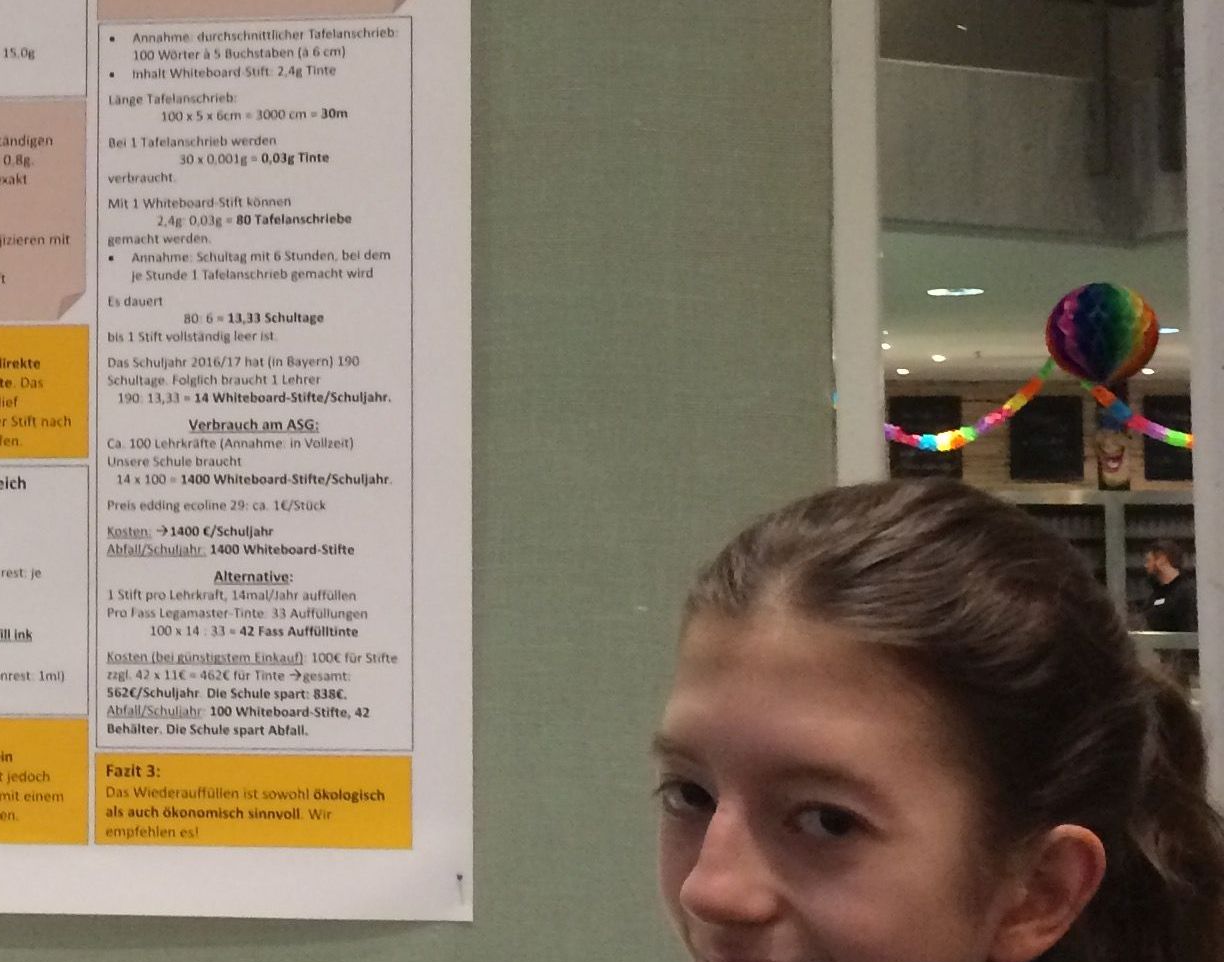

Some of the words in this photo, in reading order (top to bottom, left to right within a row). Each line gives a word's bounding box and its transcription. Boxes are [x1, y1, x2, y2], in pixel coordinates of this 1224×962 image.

[132, 67, 165, 79] Inhalt
[306, 65, 336, 76] Tinte
[108, 94, 143, 108] Länge
[147, 92, 236, 105] Tafelanschrieb:
[108, 197, 128, 209] Mit
[142, 196, 242, 209] Whiteboard-Stift
[254, 212, 352, 225] Tafelanschriebe
[107, 233, 159, 247] gemacht
[264, 311, 324, 325] Schultage
[20, 376, 43, 388] Das
[172, 374, 217, 387] Folglich
[221, 374, 267, 385] braucht
[282, 374, 320, 385] Lehrer
[212, 391, 391, 405] Whiteboard-Stifte/Schuljahr.
[189, 419, 258, 433] Verbrauch
[262, 422, 283, 433] am
[287, 419, 320, 433] ASG:
[107, 499, 136, 511] Preis
[139, 499, 180, 513] edding
[183, 499, 226, 511] ecoline
[243, 543, 354, 555] Whiteboard-Stifte
[213, 570, 293, 585] Alternative:
[13, 628, 32, 642] ink
[258, 625, 284, 636] Fass
[206, 687, 226, 699] Die
[230, 687, 270, 699] Schule
[273, 689, 309, 701] spart:
[107, 723, 162, 734] Behälter.
[166, 723, 186, 734] Die
[189, 723, 229, 735] Schule
[233, 725, 264, 737] spart
[267, 724, 308, 736] Abfall.
[6, 769, 50, 784] jedoch
[106, 763, 141, 777] Fazit
[105, 786, 129, 798] Das
[243, 789, 258, 799] ist
[262, 787, 309, 800] sowohl
[105, 806, 123, 817] als
[127, 806, 159, 818] auch
[308, 808, 331, 820] Wir
[105, 825, 175, 840] empfehlen
[179, 826, 198, 838] es!
